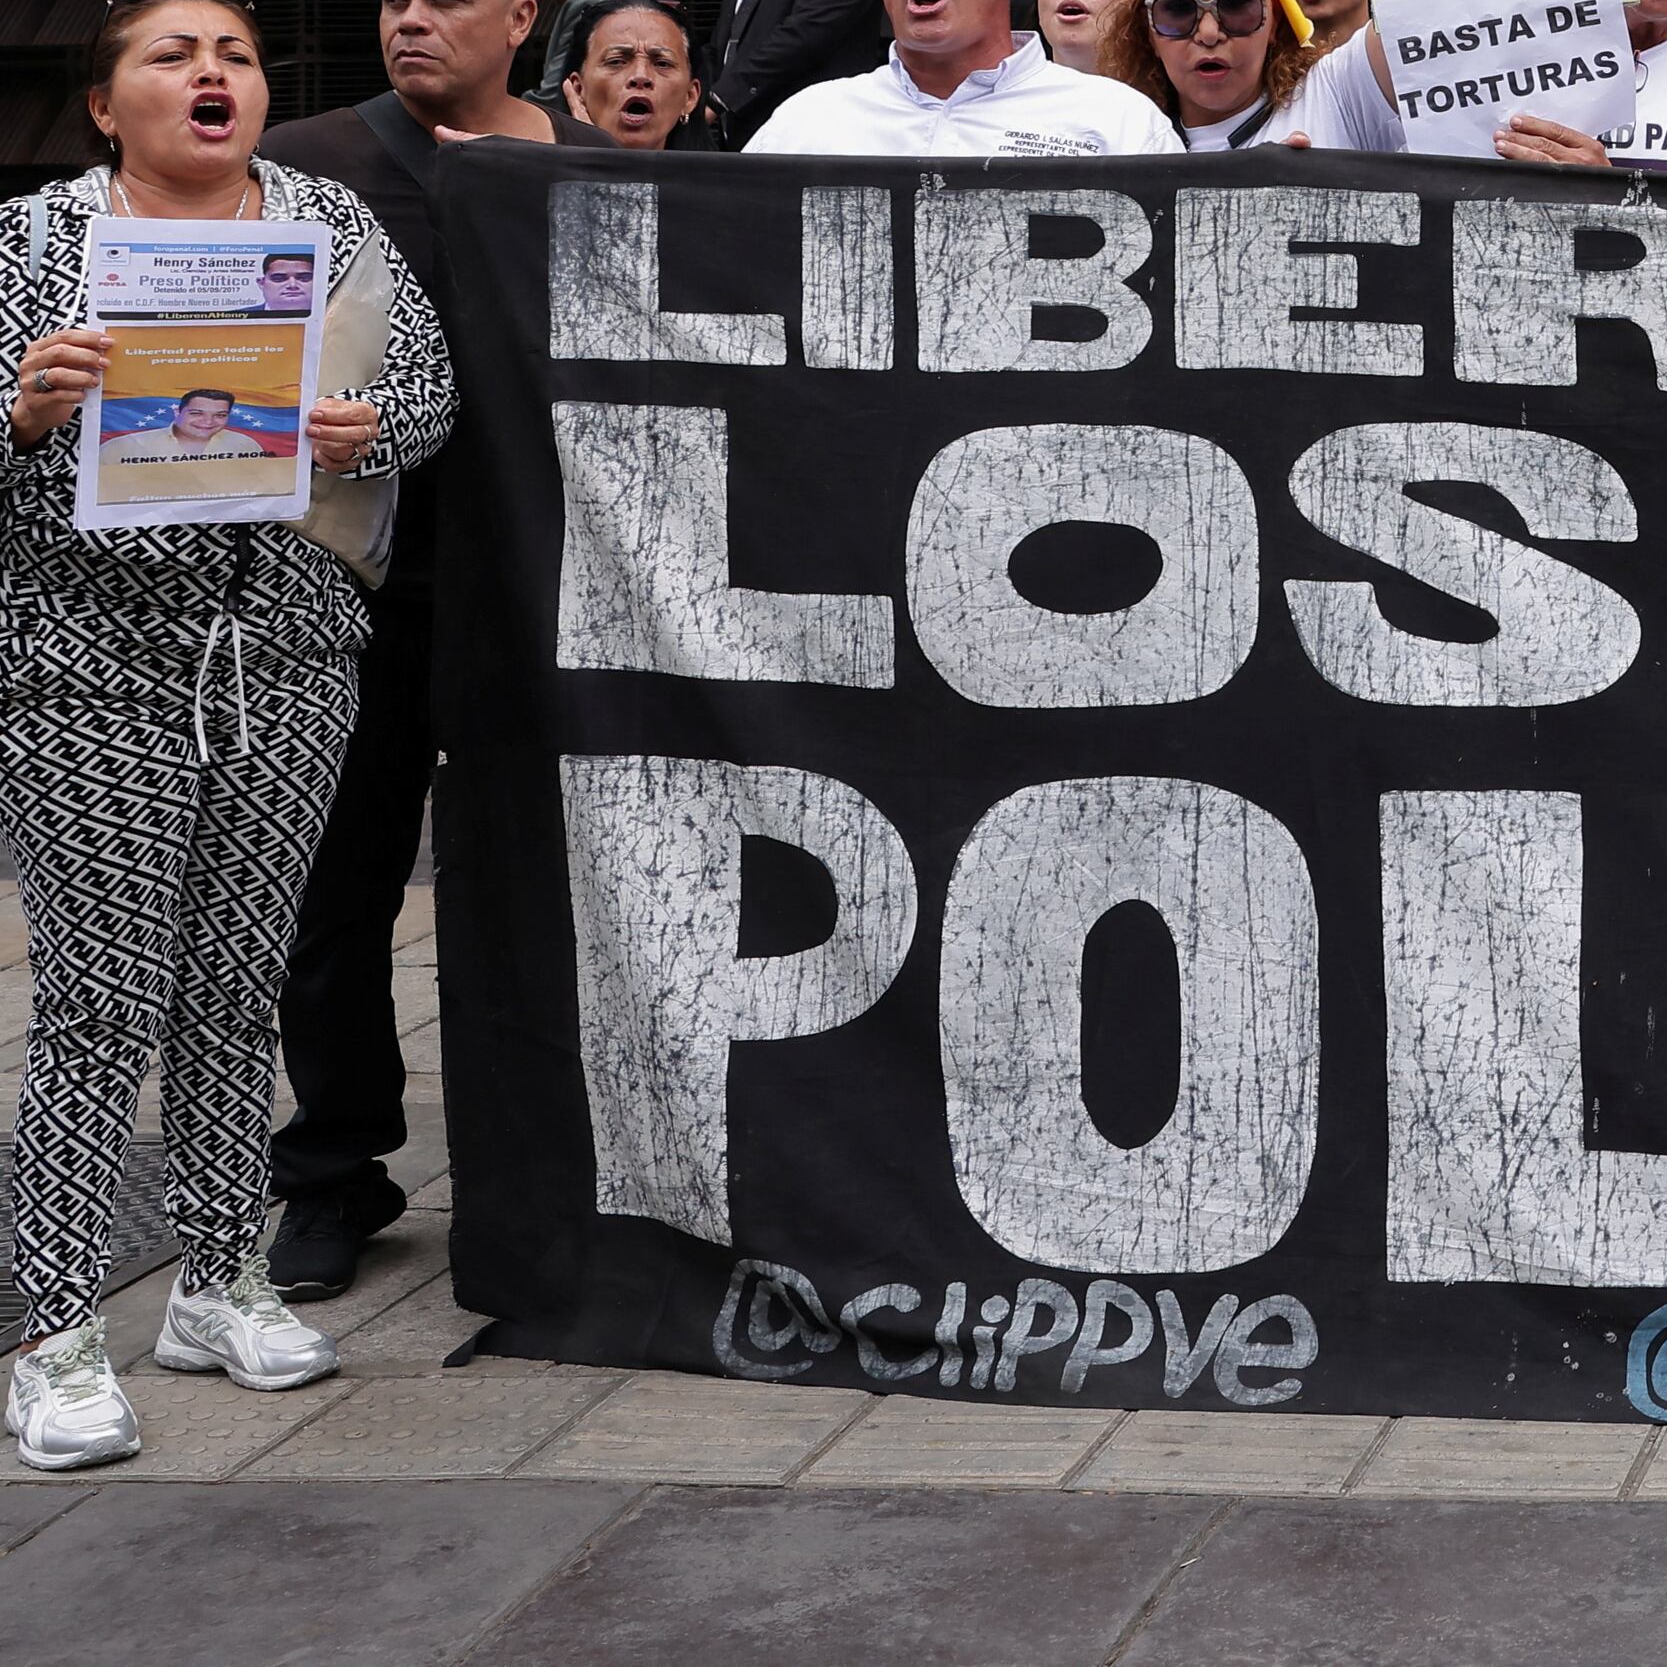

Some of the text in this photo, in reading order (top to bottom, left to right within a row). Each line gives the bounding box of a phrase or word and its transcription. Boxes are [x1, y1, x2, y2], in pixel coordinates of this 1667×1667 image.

[1397, 0, 1601, 65] BASTA DE
[1398, 51, 1620, 119] TORTURAS
[139, 274, 250, 286] Preso Político
[153, 257, 256, 270] Henry Sánchez
[121, 455, 167, 464] HENRY
[171, 452, 234, 463] SÁNCHEZ
[555, 400, 1642, 708] LOS
